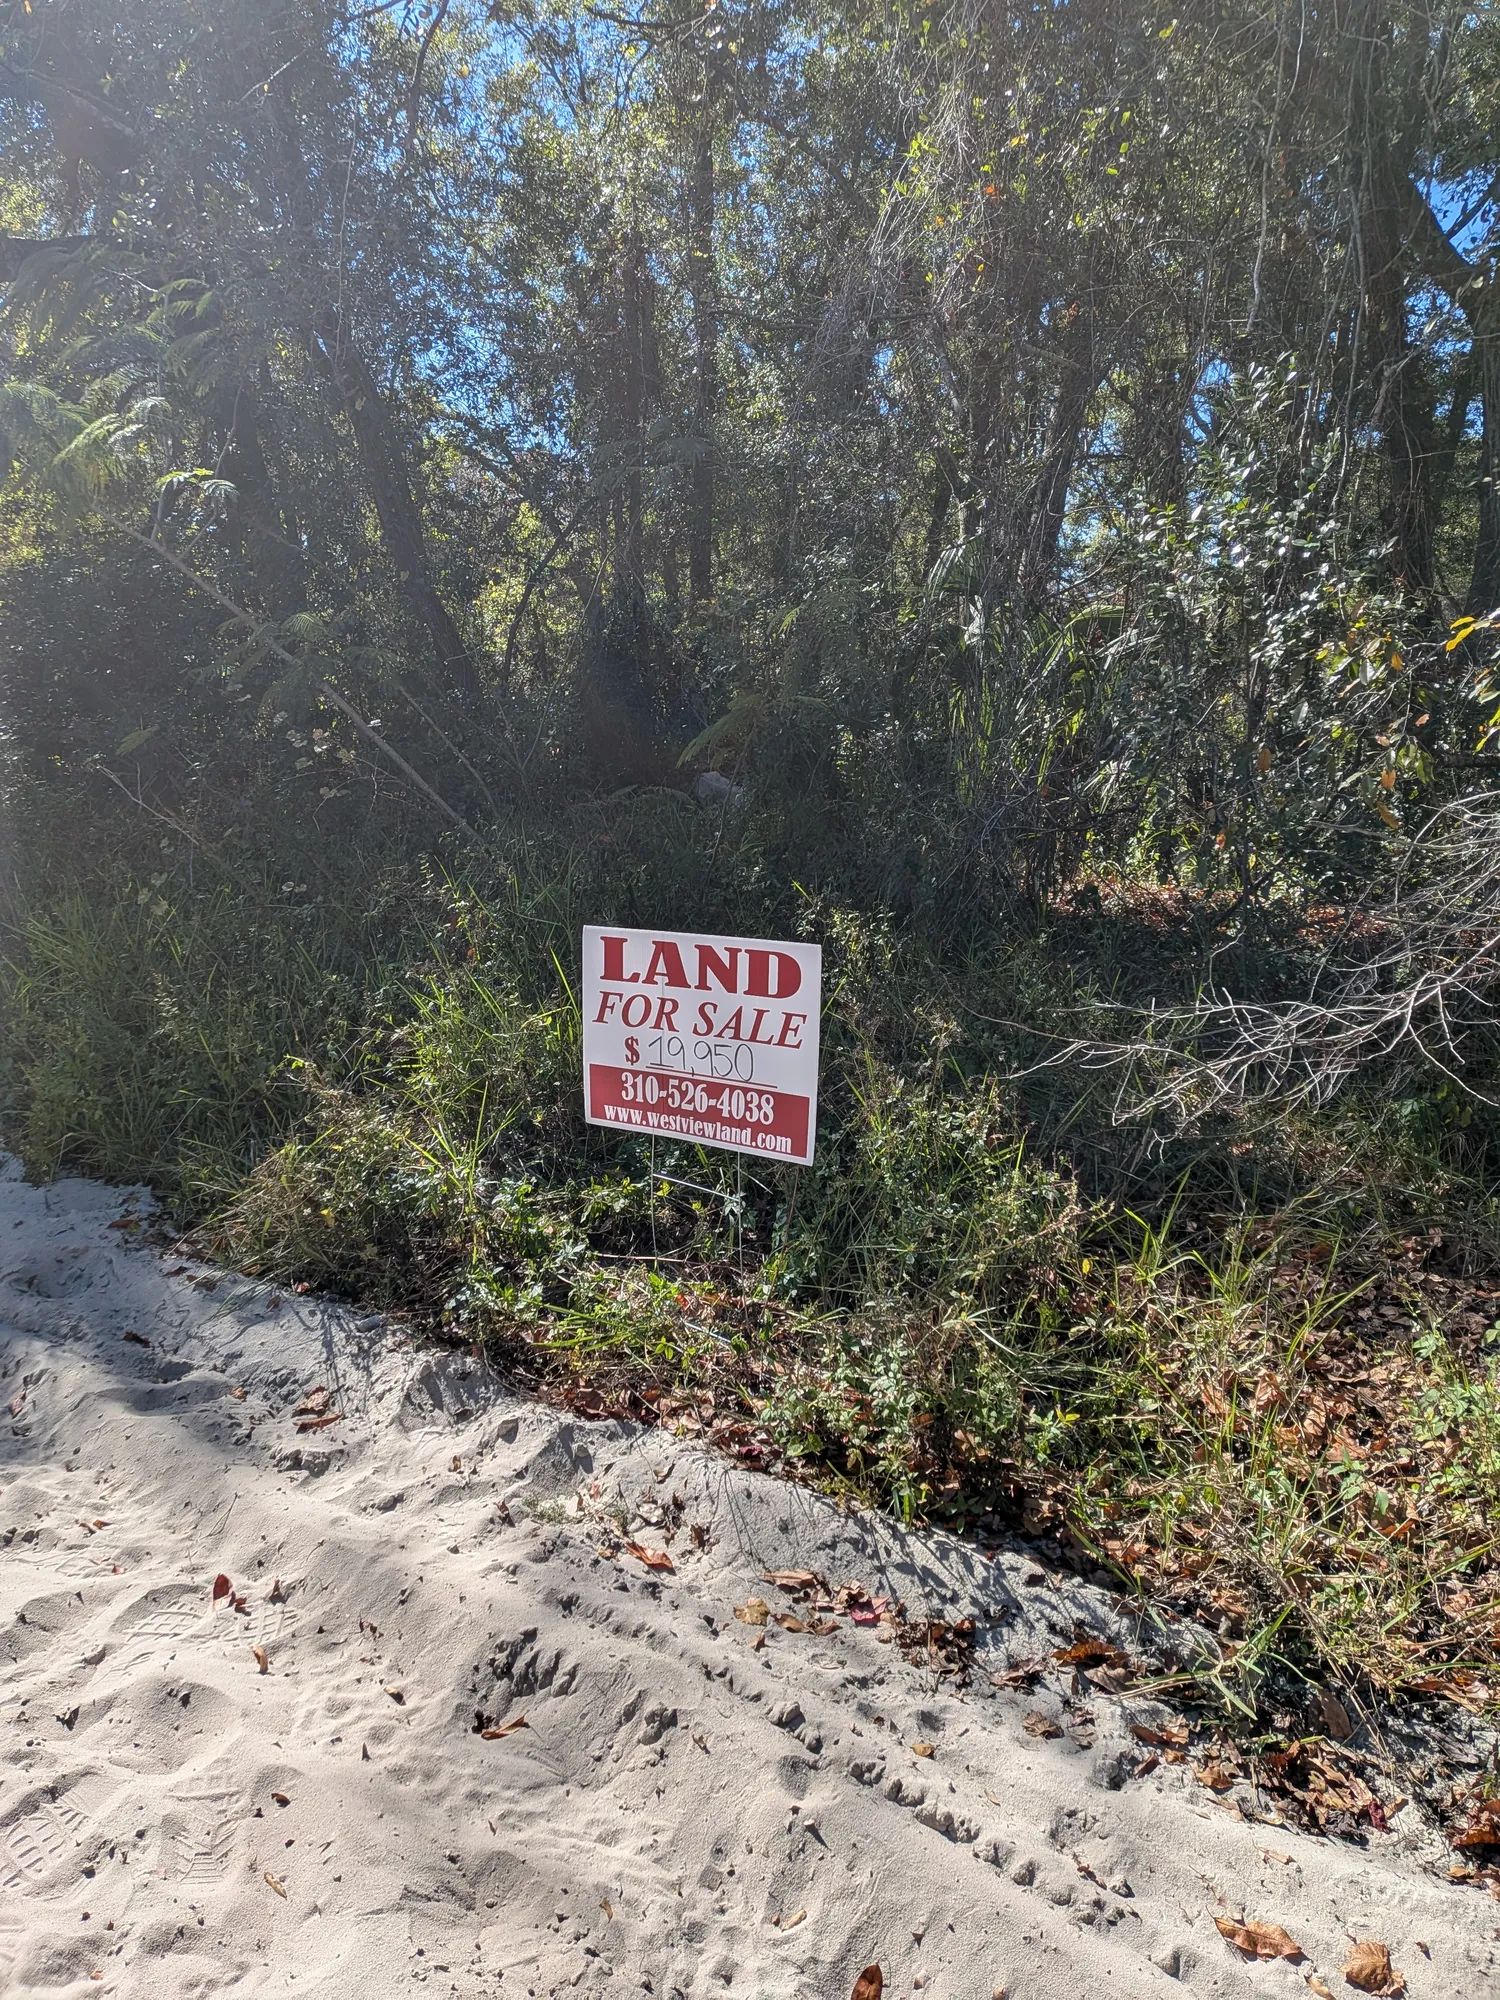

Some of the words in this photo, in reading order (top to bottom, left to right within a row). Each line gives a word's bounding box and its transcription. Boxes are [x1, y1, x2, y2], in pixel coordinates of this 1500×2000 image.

[600, 936, 802, 999] LAND
[592, 991, 680, 1033] FOR
[692, 1001, 807, 1050] SALE
[624, 1036, 640, 1066] $
[648, 1036, 754, 1082] 19,950
[621, 1072, 775, 1125] 310-526-4038
[604, 1104, 792, 1154] www.westviewland.com
